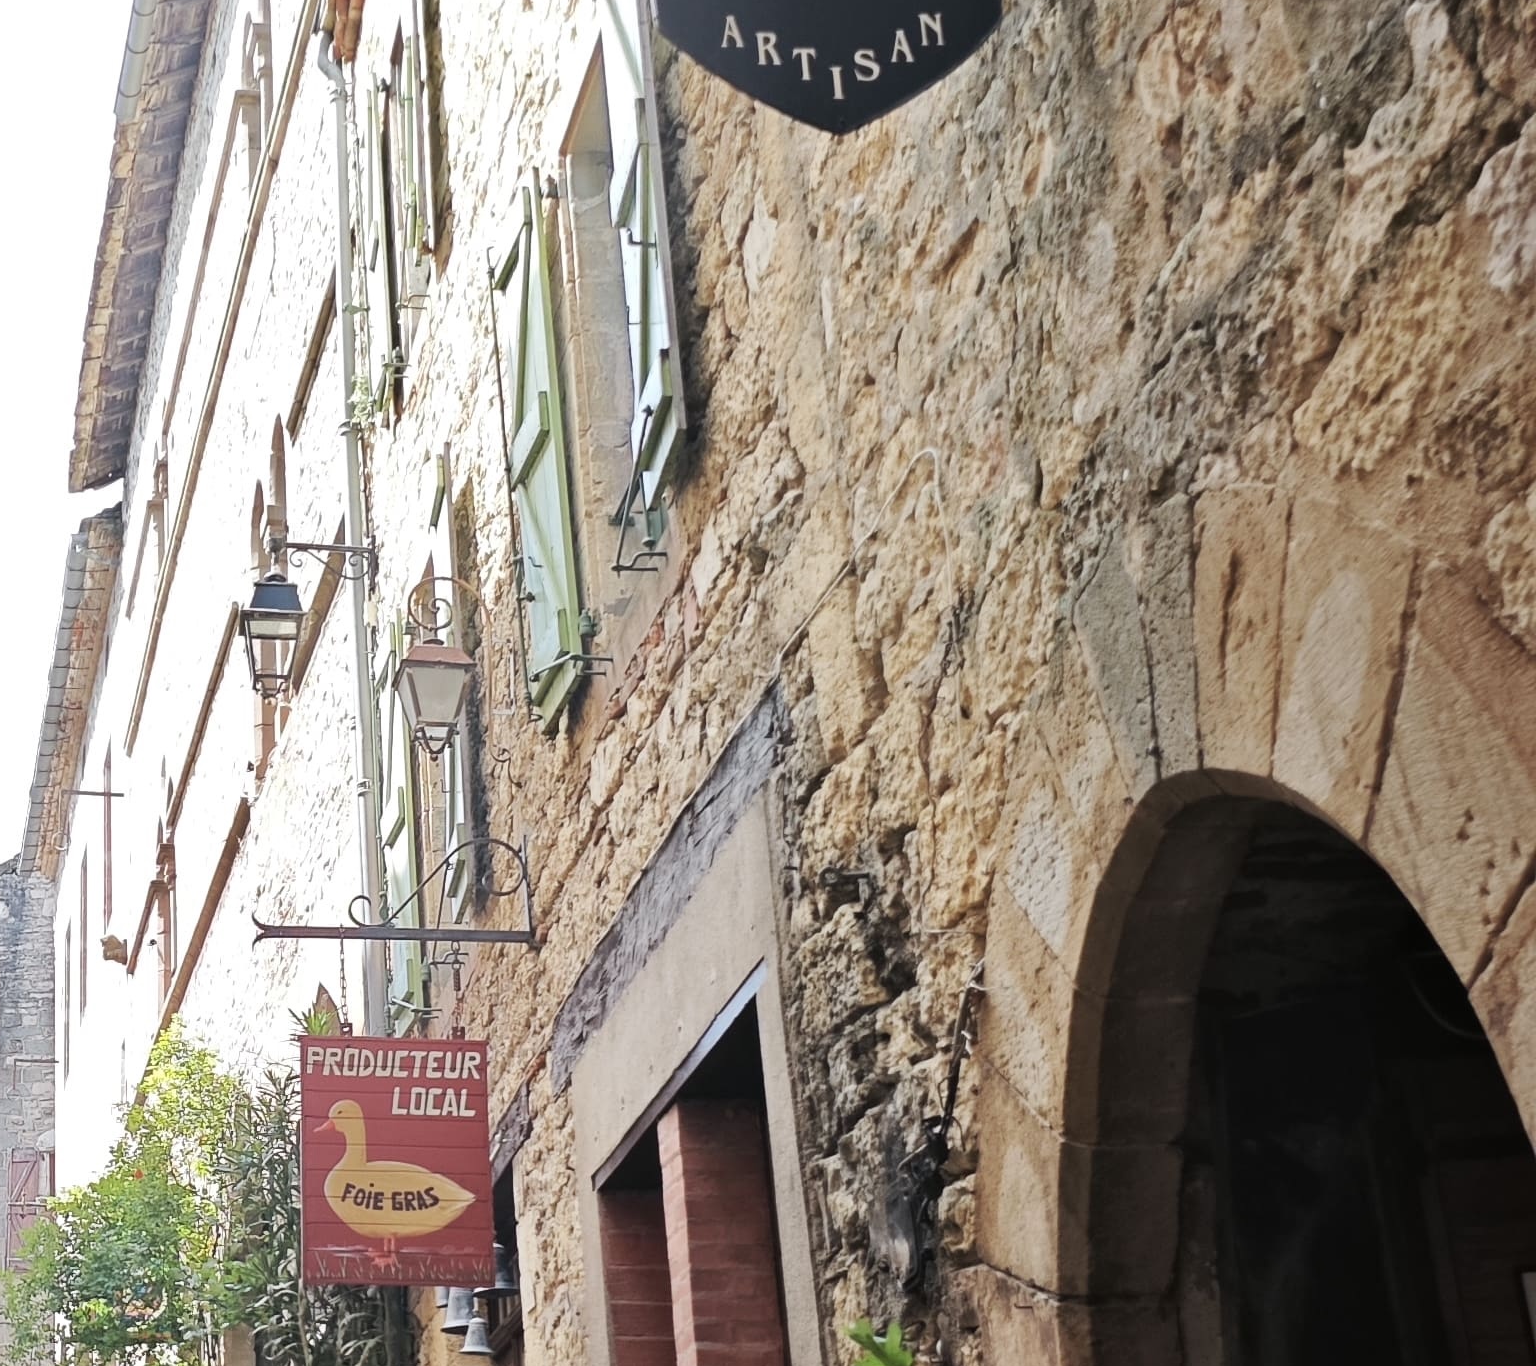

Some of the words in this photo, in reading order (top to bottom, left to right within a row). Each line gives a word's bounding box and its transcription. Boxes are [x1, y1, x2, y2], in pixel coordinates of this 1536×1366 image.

[721, 12, 944, 100] ARTISAN
[305, 1046, 481, 1080] PRODUCTEUR
[391, 1086, 476, 1117] LOCAL
[341, 1182, 385, 1211] FOIE
[391, 1186, 440, 1212] GRAS
